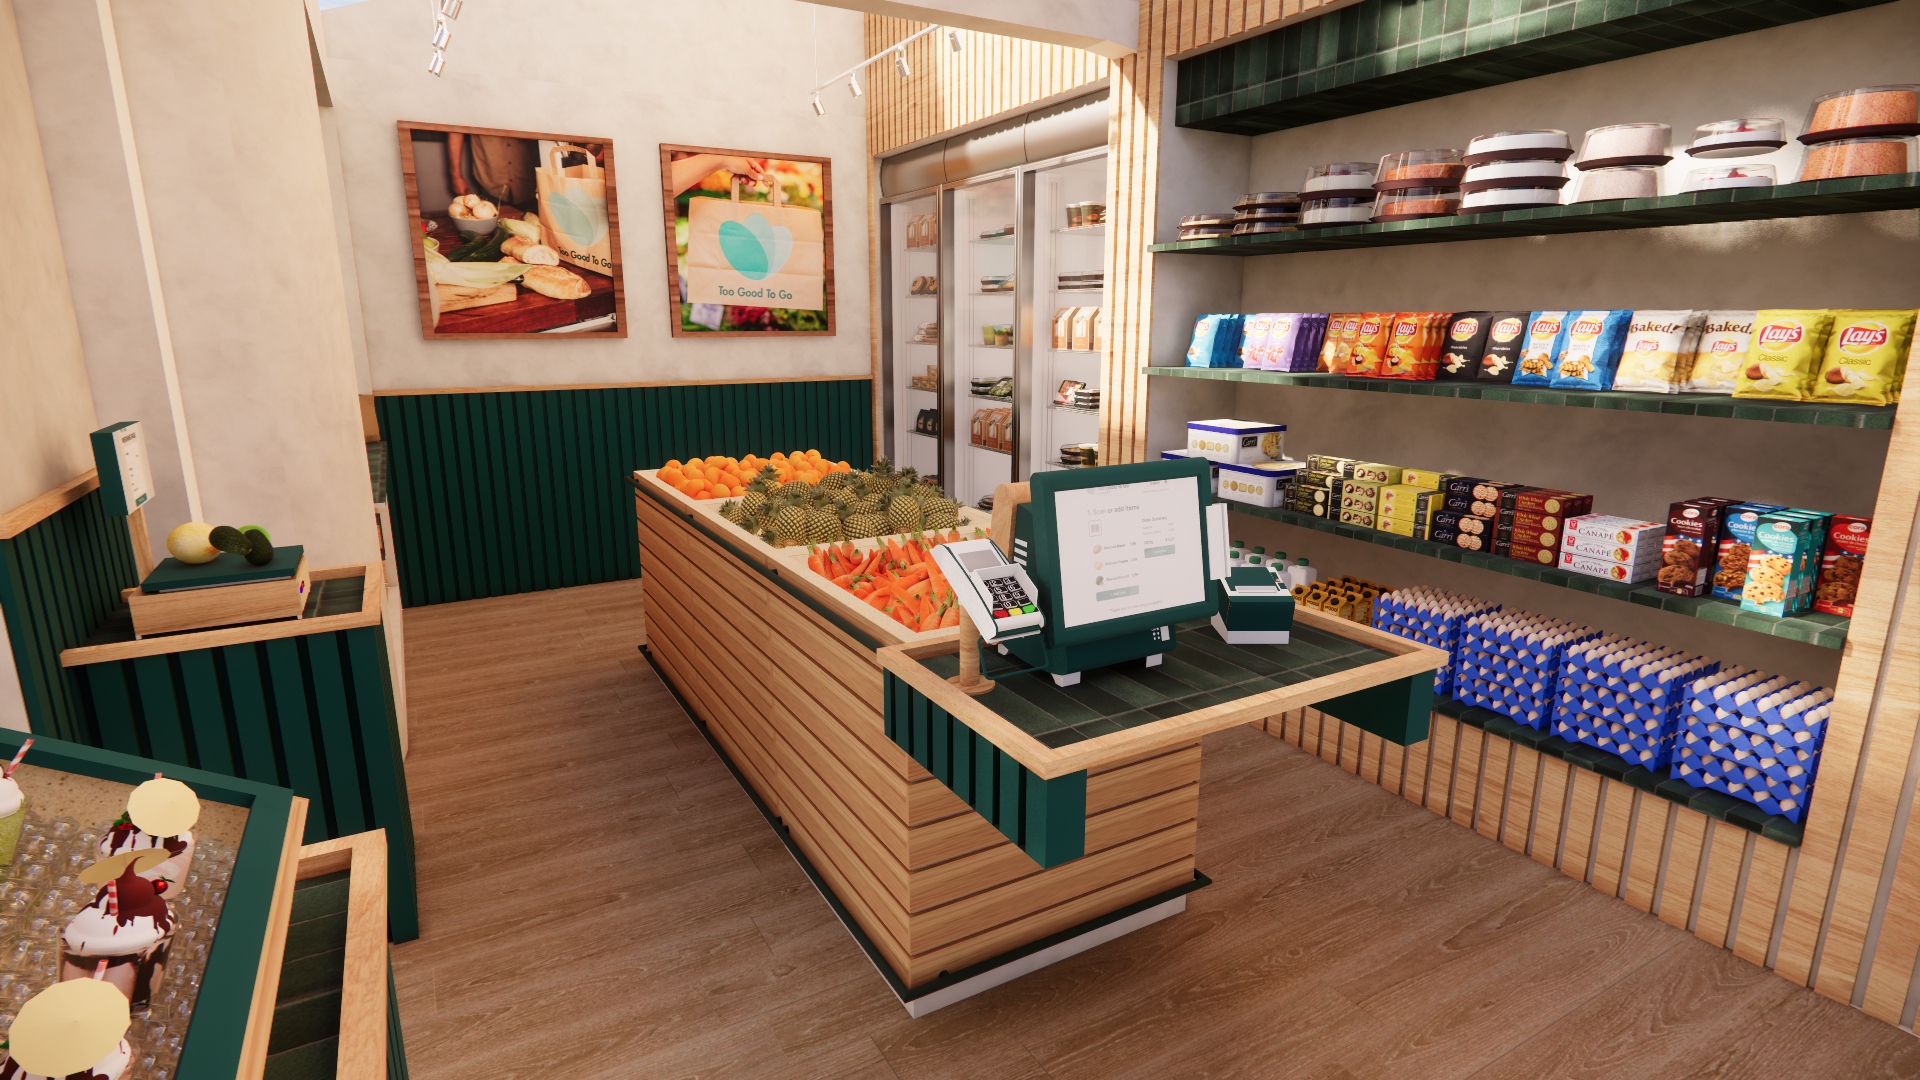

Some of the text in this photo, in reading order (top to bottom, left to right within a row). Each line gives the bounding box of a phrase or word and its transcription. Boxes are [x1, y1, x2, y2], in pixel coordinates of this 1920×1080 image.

[558, 246, 612, 269] Too Good To Go
[718, 286, 793, 300] Too Good To Go
[1360, 322, 1380, 335] Lay's
[1396, 323, 1417, 336] Lay's
[1453, 321, 1477, 334] Lay's
[1494, 321, 1520, 334] Lay's
[1533, 321, 1560, 334] Lay's
[1571, 321, 1602, 335] Lay's
[1630, 321, 1675, 334] Baked!
[1761, 325, 1801, 344] Lay's
[1841, 328, 1886, 345] Lay's
[1638, 340, 1659, 352] Lay's
[1712, 340, 1737, 352] Lay's
[1758, 354, 1788, 362] Classic
[1839, 357, 1871, 365] Classic
[1450, 483, 1470, 492] Carr's
[1448, 499, 1468, 508] Carr's
[1436, 515, 1456, 525] Carr's
[1671, 518, 1703, 528] Cookies
[1728, 521, 1756, 532] Cookie
[1434, 530, 1454, 541] Carr's
[1578, 528, 1614, 540] CANAPÉ
[1758, 531, 1795, 542] Cookies
[1575, 545, 1612, 557] CANAPÉ
[1573, 562, 1609, 575] CANAPÉ
